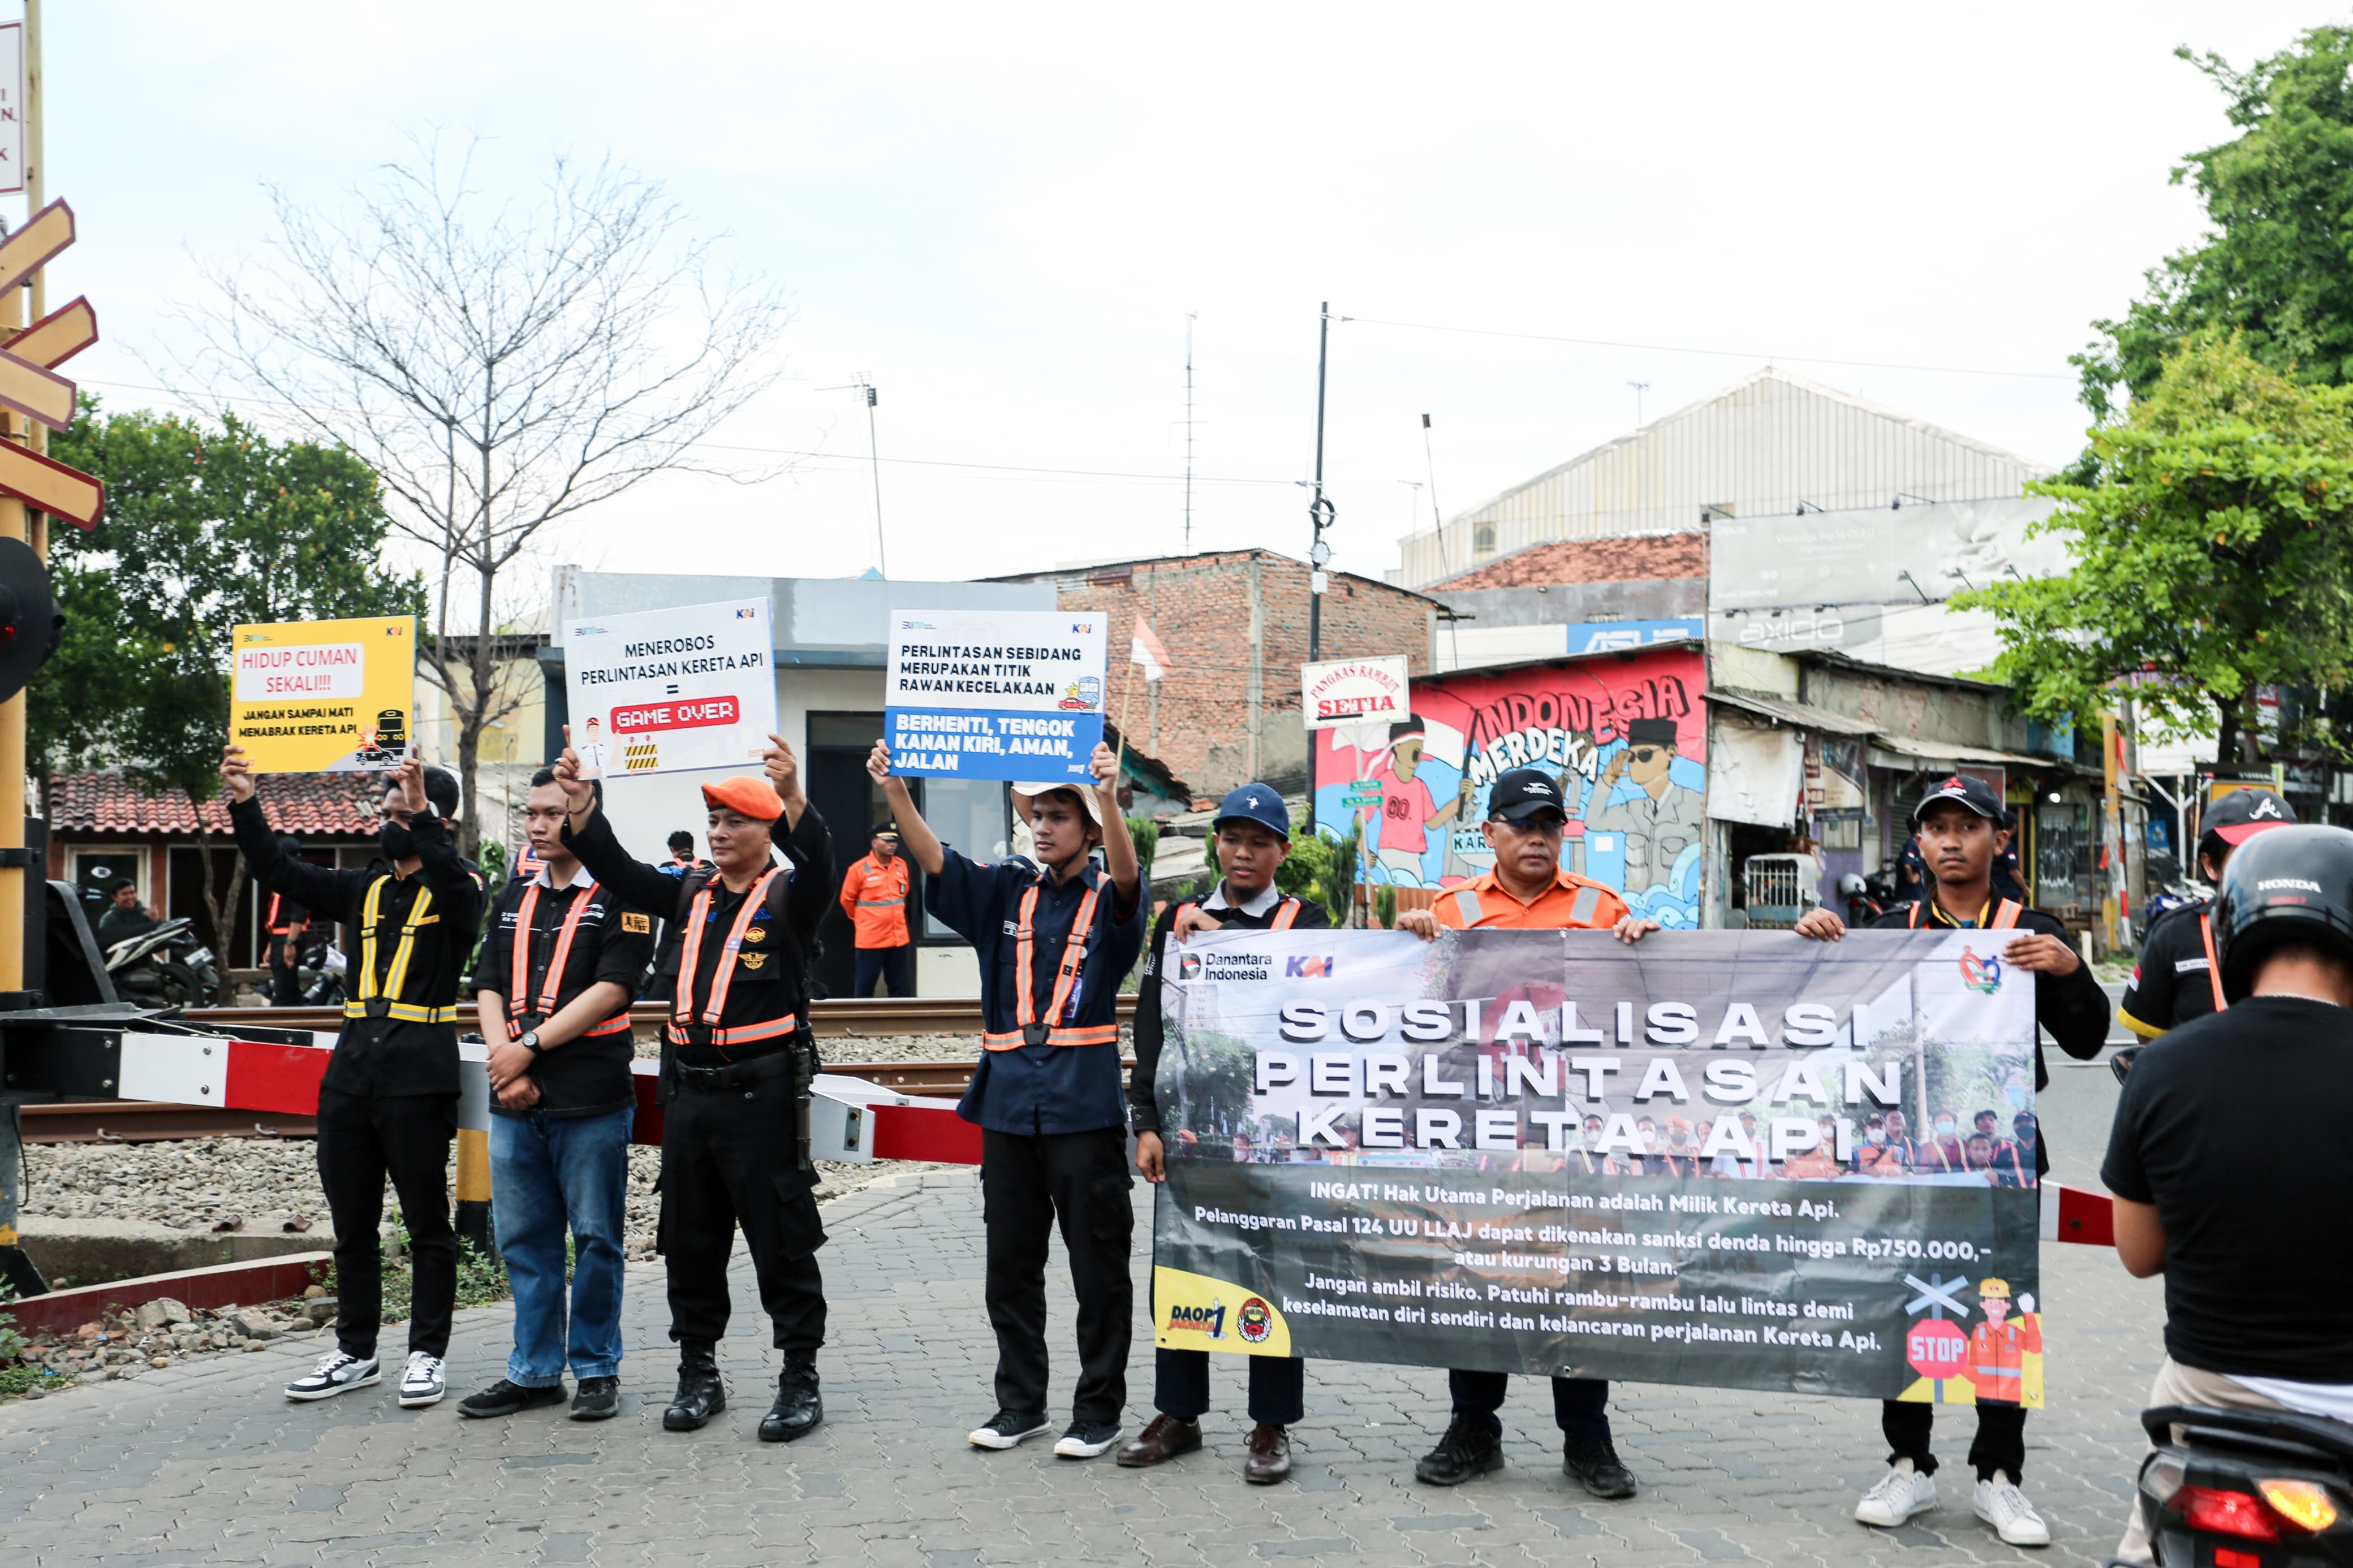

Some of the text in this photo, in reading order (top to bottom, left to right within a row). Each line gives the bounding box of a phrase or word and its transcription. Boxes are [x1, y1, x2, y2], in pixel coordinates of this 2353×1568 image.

[625, 634, 714, 658] MENEROBOS
[902, 645, 1081, 661] PERLINTASAN SEBIDANG
[242, 649, 357, 669] HIDUP CUMAN
[581, 653, 763, 685] PERLINTASAN KERETA API
[900, 662, 1031, 677] MERUPAKAN TITIK
[266, 675, 331, 693] SEKALI!!!
[666, 684, 678, 694] =
[899, 679, 1054, 696] RAWAN KECELAKAAN
[1310, 665, 1400, 699] PANGKAS RAMBUT
[243, 707, 354, 720] JANGAN SAMPAI MATI
[617, 701, 733, 728] GAME OVER
[1317, 696, 1395, 716] SETIA
[1474, 675, 1690, 751] INDONESIA
[239, 724, 357, 737] MENABRAK KERETA API
[896, 714, 1076, 737] BERHENTI, TENGOK
[894, 733, 1074, 759] KANAN KIRI, AMAN,
[1470, 727, 1598, 787] MERDEKA
[894, 751, 959, 771] JALAN
[1454, 836, 1486, 850] KAR
[2257, 879, 2321, 893] HONDA
[1206, 953, 1272, 965] Danantara
[1286, 956, 1333, 978] KAI
[1205, 967, 1267, 980] Indonesia
[1280, 999, 1871, 1047] SOSIALISASI
[1255, 1051, 1902, 1106] PERLINTASAN
[1298, 1105, 1853, 1161] KERETA API
[1310, 1182, 1378, 1201] INGAT!
[1384, 1185, 1420, 1203] Hak
[1425, 1186, 1486, 1206] Utama
[1492, 1188, 1594, 1212] Perjalanan
[1599, 1193, 1664, 1212] adalah
[1670, 1194, 1717, 1215] Milik
[1723, 1196, 1792, 1217] Kereta
[1798, 1198, 1840, 1222] Api.
[1195, 1206, 1297, 1232] Pelanggaran
[1301, 1215, 1347, 1234] Pasal
[1352, 1216, 1383, 1235] 124
[1389, 1218, 1418, 1237] UU
[1424, 1220, 1472, 1239] LLAJ
[1478, 1223, 1533, 1245] dapat
[1538, 1225, 1637, 1247] dikenakan
[1641, 1229, 1701, 1249] sanksi
[1707, 1232, 1770, 1252] denda
[1775, 1234, 1847, 1259] hingga
[1852, 1239, 1992, 1262] Rp750.000,-
[1454, 1250, 1679, 1276] atau kurungan 3 Bulan.
[1304, 1273, 1854, 1321] Jangan ambil risiko. Patuhi rambu-rambu lalu lintas demi
[1167, 1319, 1214, 1332] JAKARTA
[1283, 1297, 1389, 1324] keselamatan
[1394, 1305, 1425, 1324] diri
[1430, 1307, 1495, 1329] sendiri
[1499, 1312, 1535, 1332] dan
[1540, 1315, 1645, 1340] kelancaran
[1651, 1320, 1757, 1345] perjalanan
[1764, 1325, 1833, 1349] Kereta
[1838, 1330, 1881, 1354] Api.
[1911, 1336, 1964, 1362] STOP
